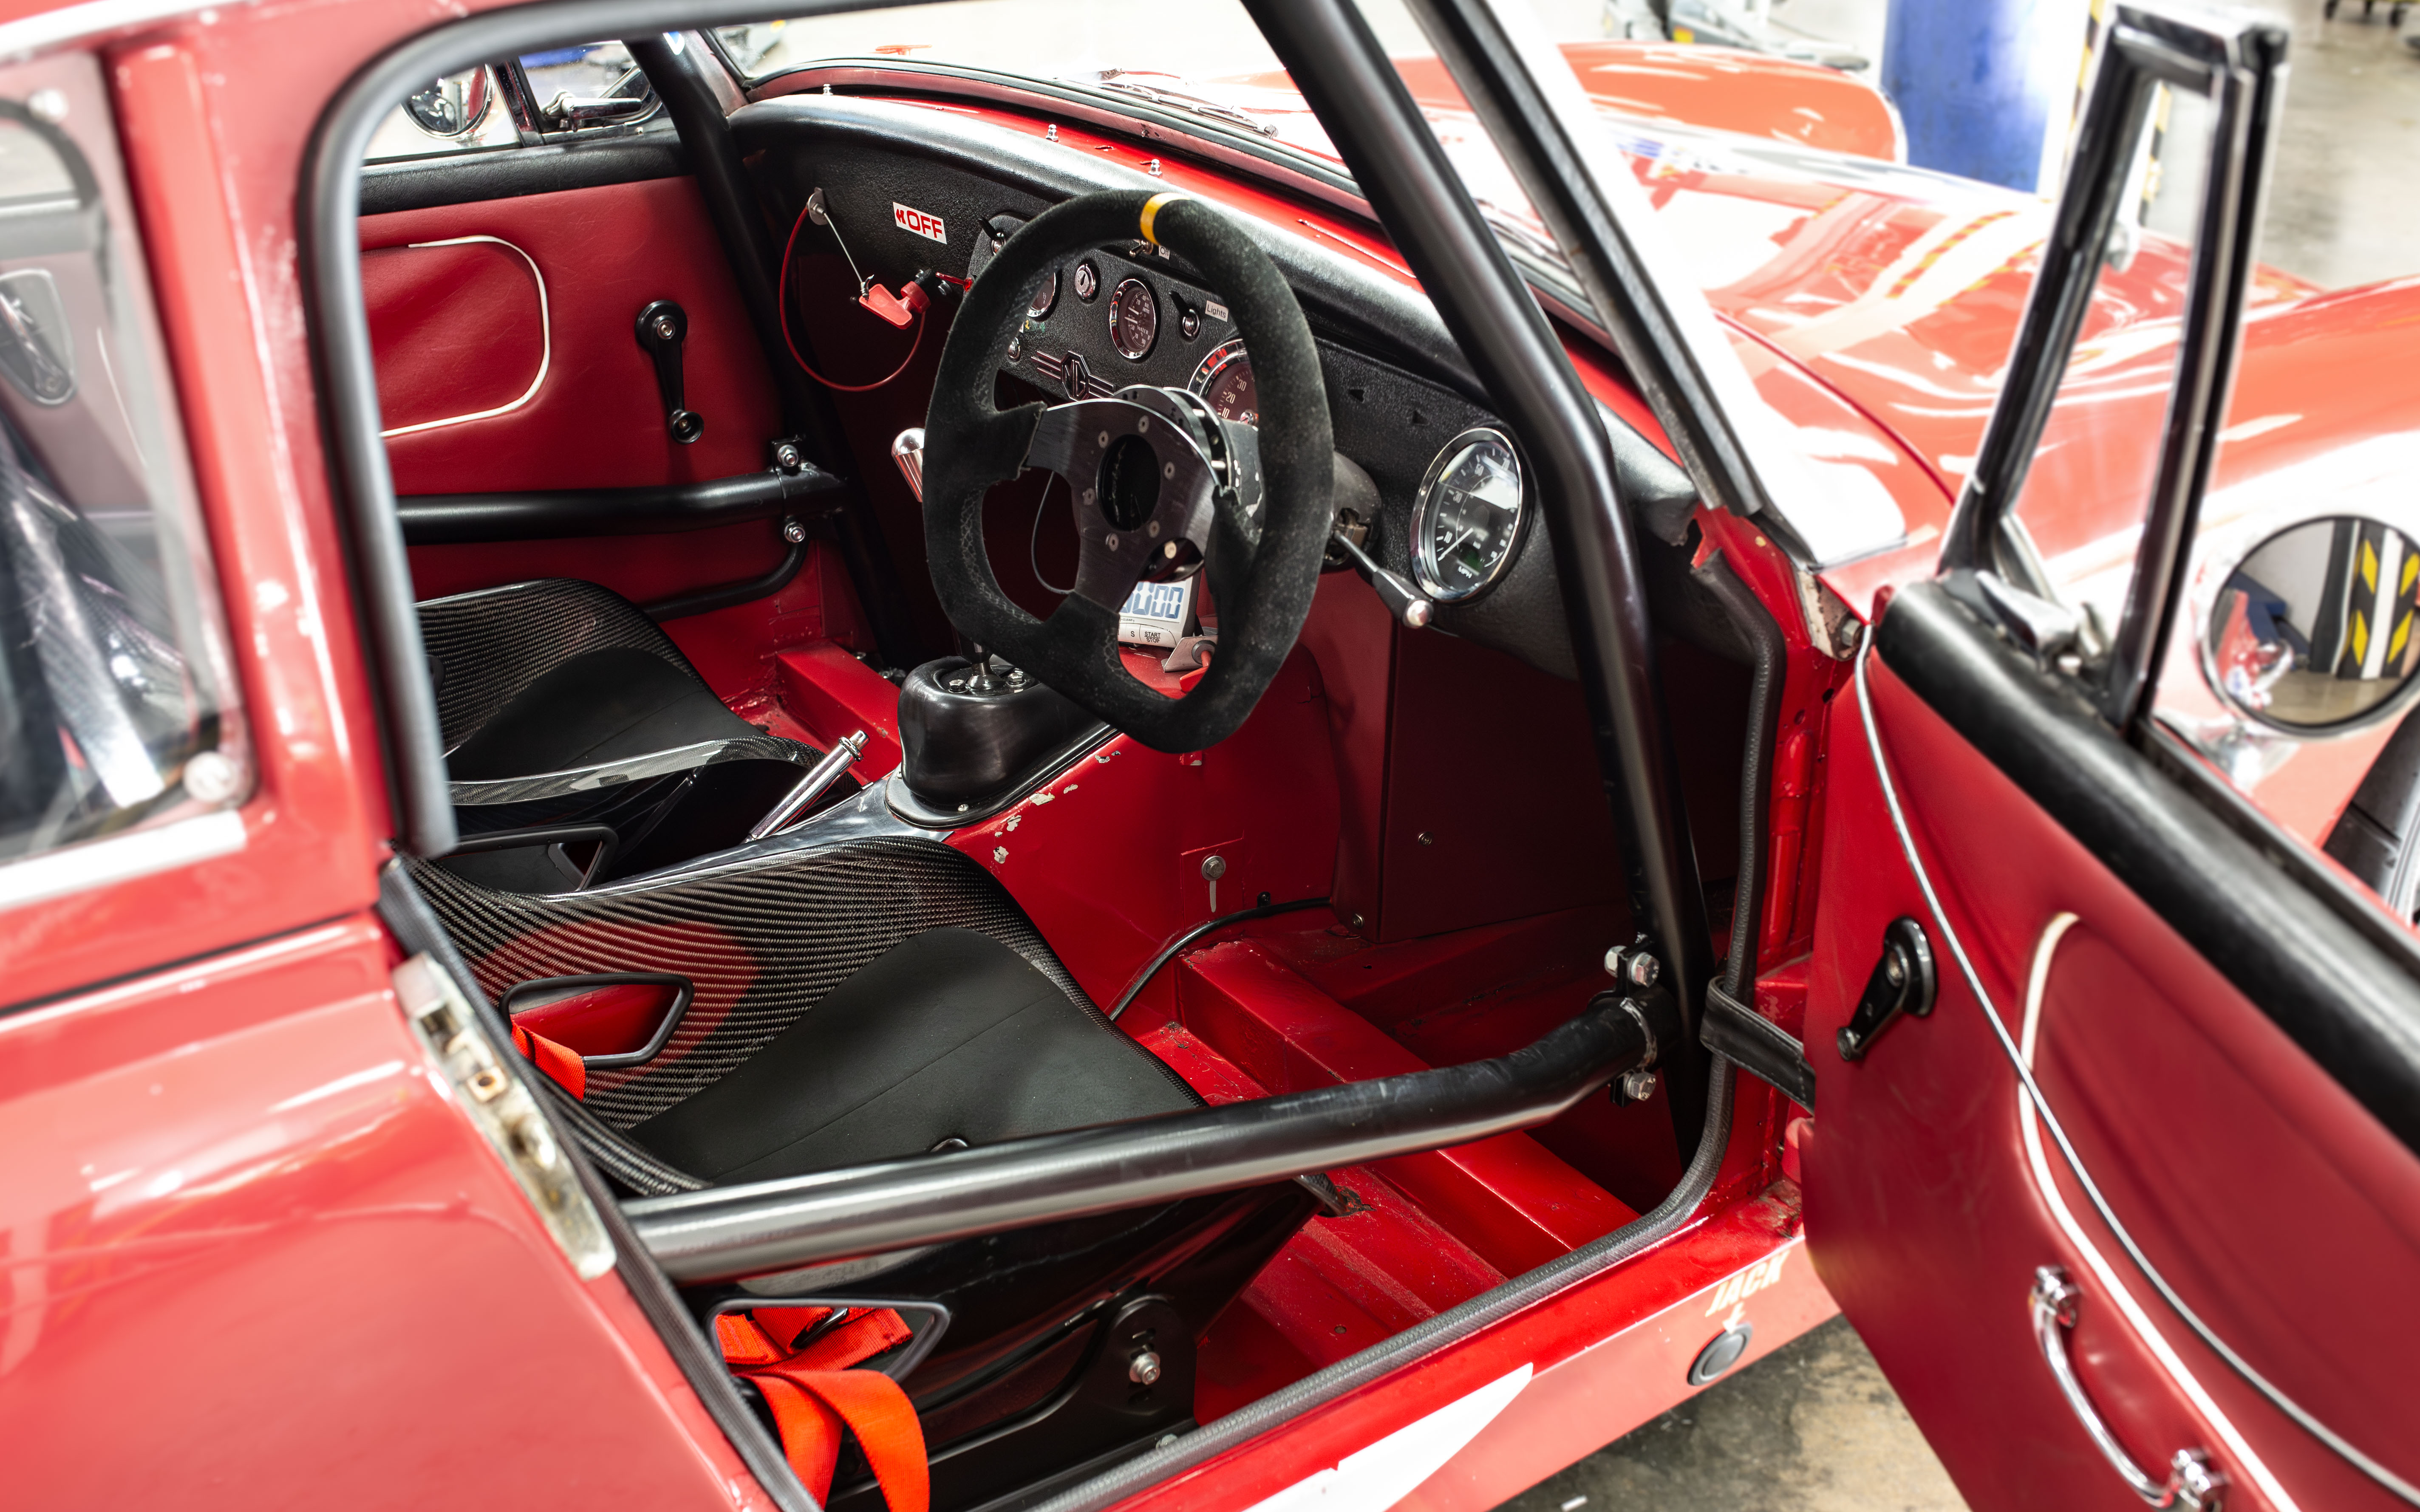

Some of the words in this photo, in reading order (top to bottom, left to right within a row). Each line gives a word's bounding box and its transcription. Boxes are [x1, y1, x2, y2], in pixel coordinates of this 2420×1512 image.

[906, 210, 943, 238] OFF
[1207, 304, 1226, 319] Lights
[1137, 325, 1149, 335] WATER
[1063, 359, 1087, 397] MG
[1237, 379, 1247, 391] 30
[1226, 391, 1236, 404] 20
[1221, 407, 1230, 419] 10
[1474, 463, 1484, 476] 50
[1453, 490, 1463, 503] 30
[1444, 531, 1453, 544] 10
[1458, 565, 1472, 579] MPH
[1704, 1249, 1791, 1318] JACK
